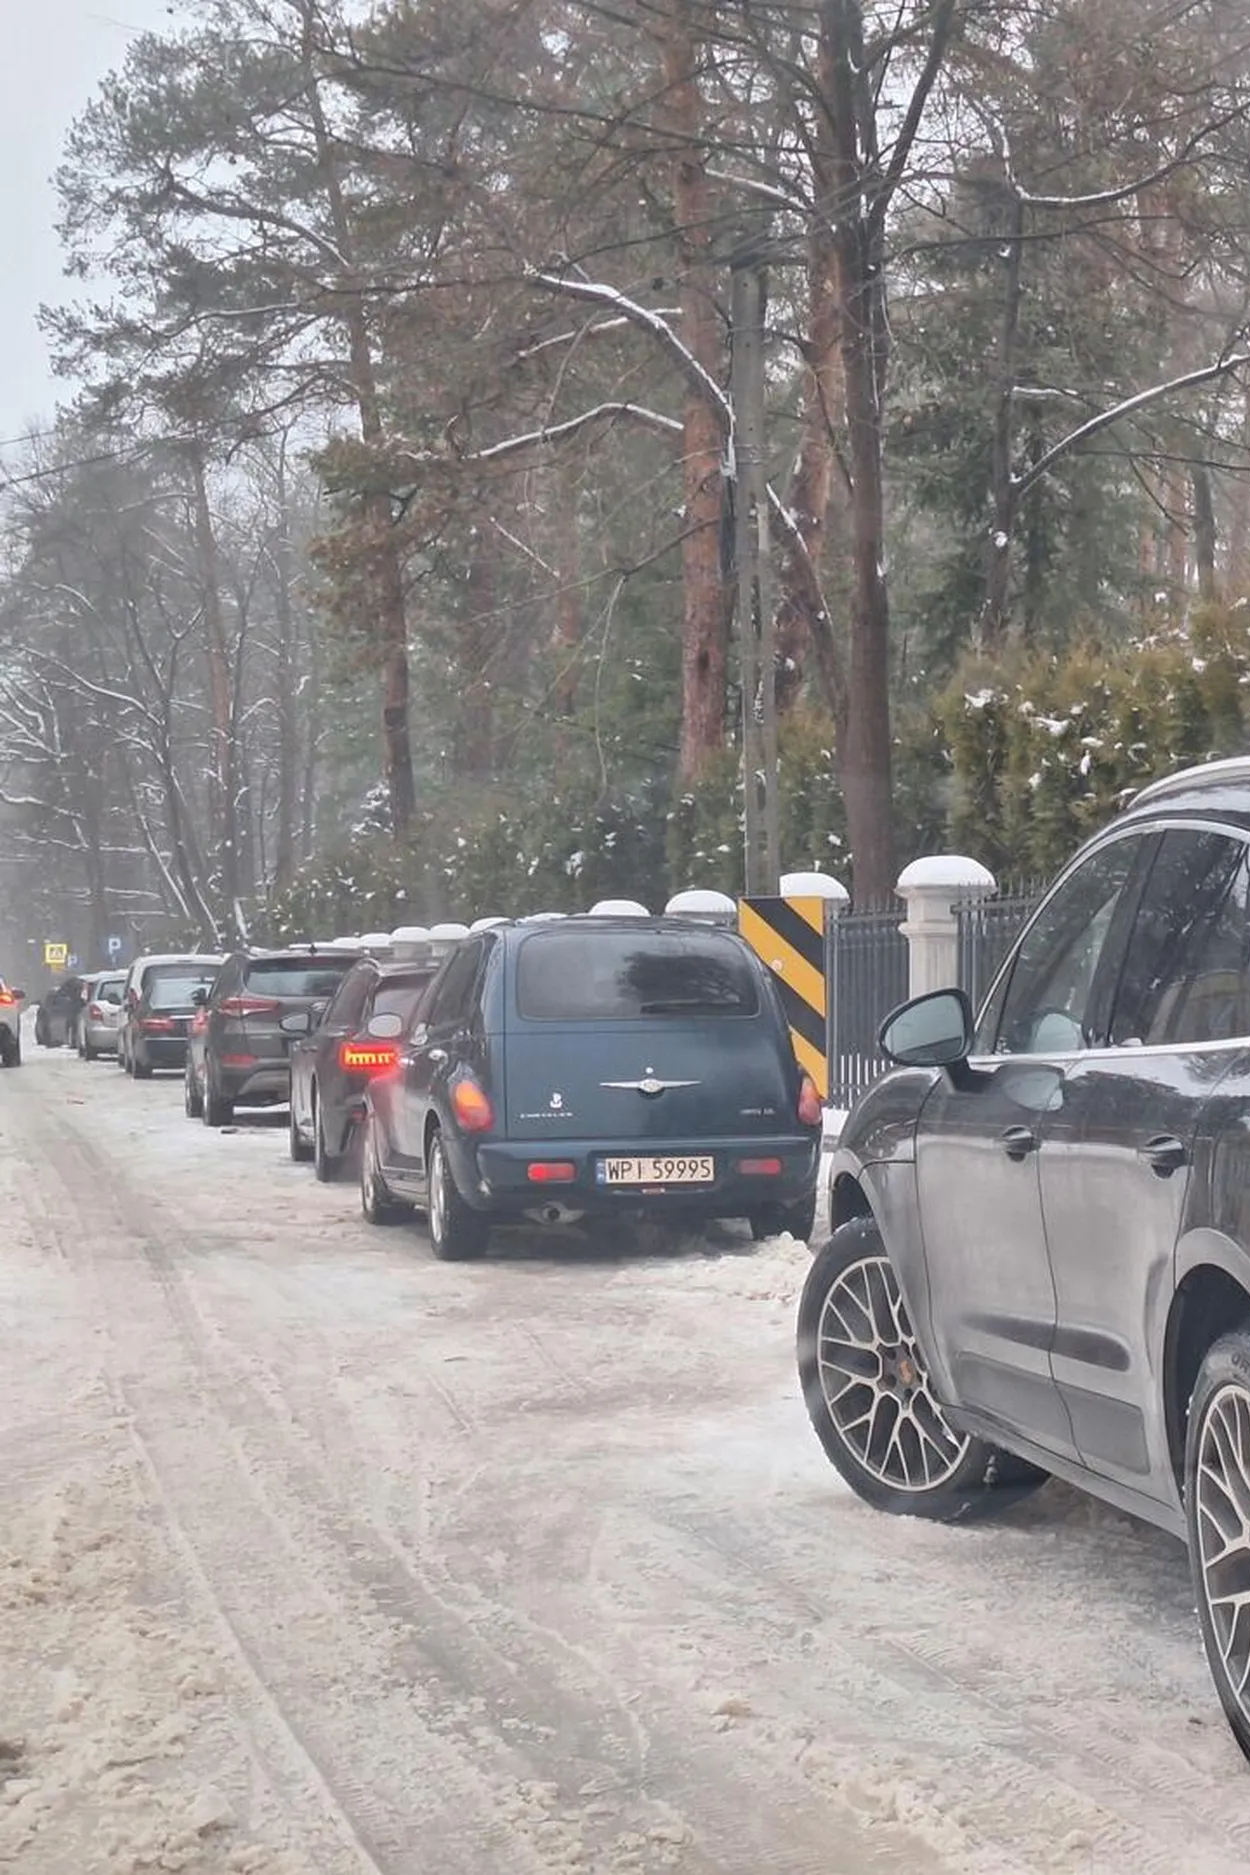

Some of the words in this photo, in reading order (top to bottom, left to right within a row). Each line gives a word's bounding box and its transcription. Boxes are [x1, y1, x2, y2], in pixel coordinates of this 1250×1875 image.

[108, 938, 121, 955] P
[608, 1161, 641, 1180] WPI
[653, 1160, 711, 1179] 59995
